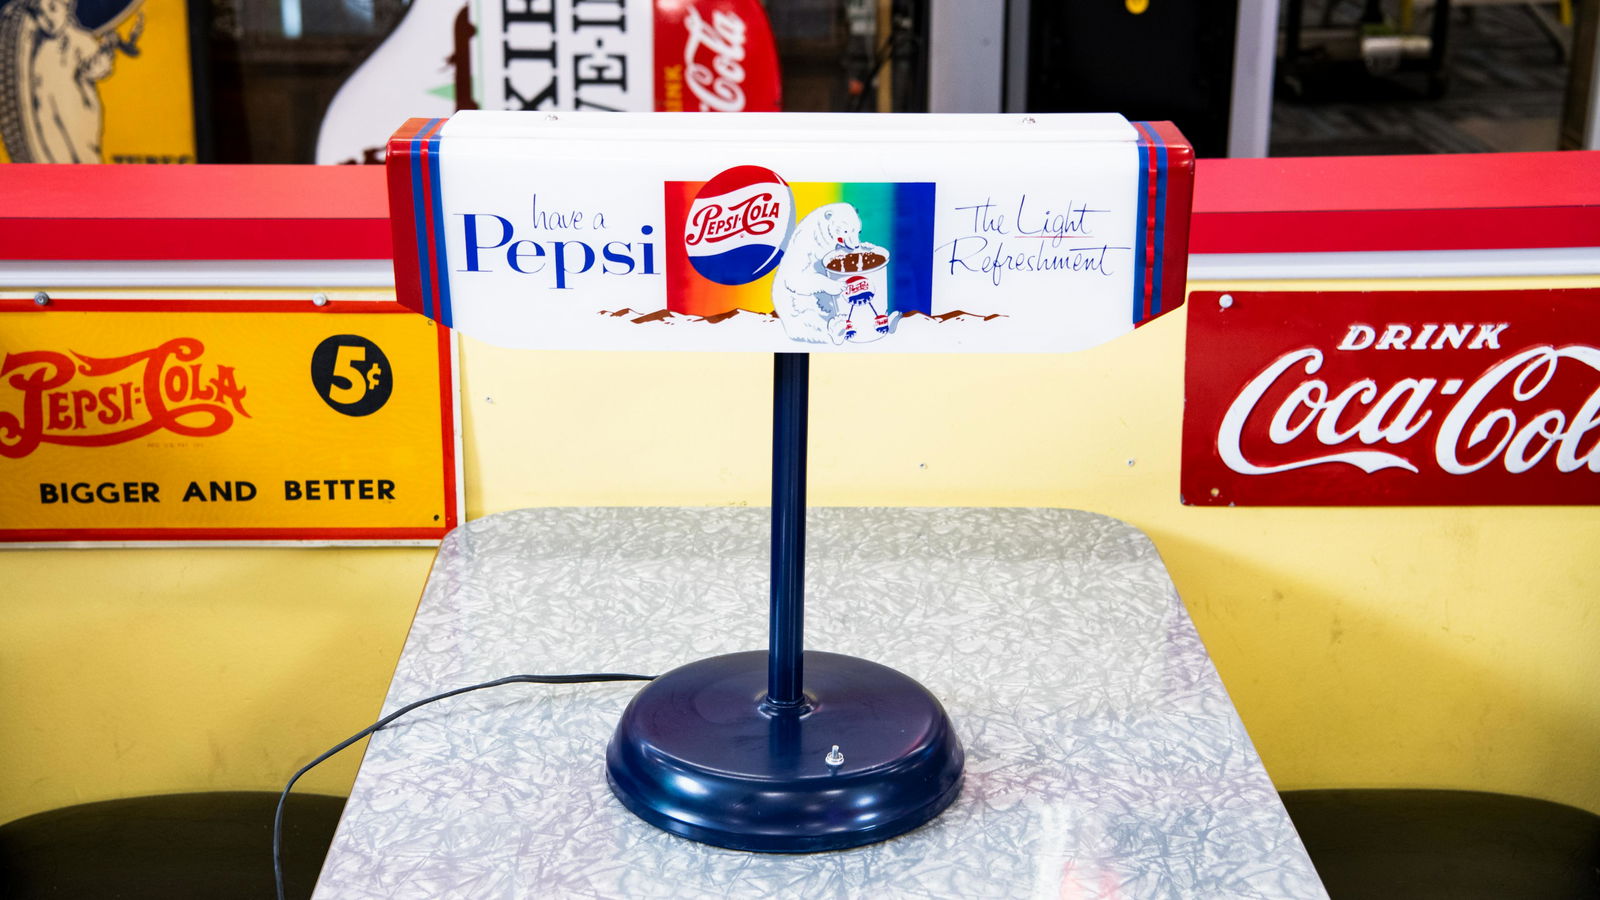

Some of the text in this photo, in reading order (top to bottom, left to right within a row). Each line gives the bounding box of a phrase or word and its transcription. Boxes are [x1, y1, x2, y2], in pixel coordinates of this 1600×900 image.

[531, 194, 608, 231] have a
[954, 193, 1112, 249] The Light
[453, 212, 661, 290] Pepsi
[934, 235, 1133, 287] Refreshment
[1336, 322, 1510, 351] DRINK
[39, 479, 396, 504] BIGGER AND BETTER
